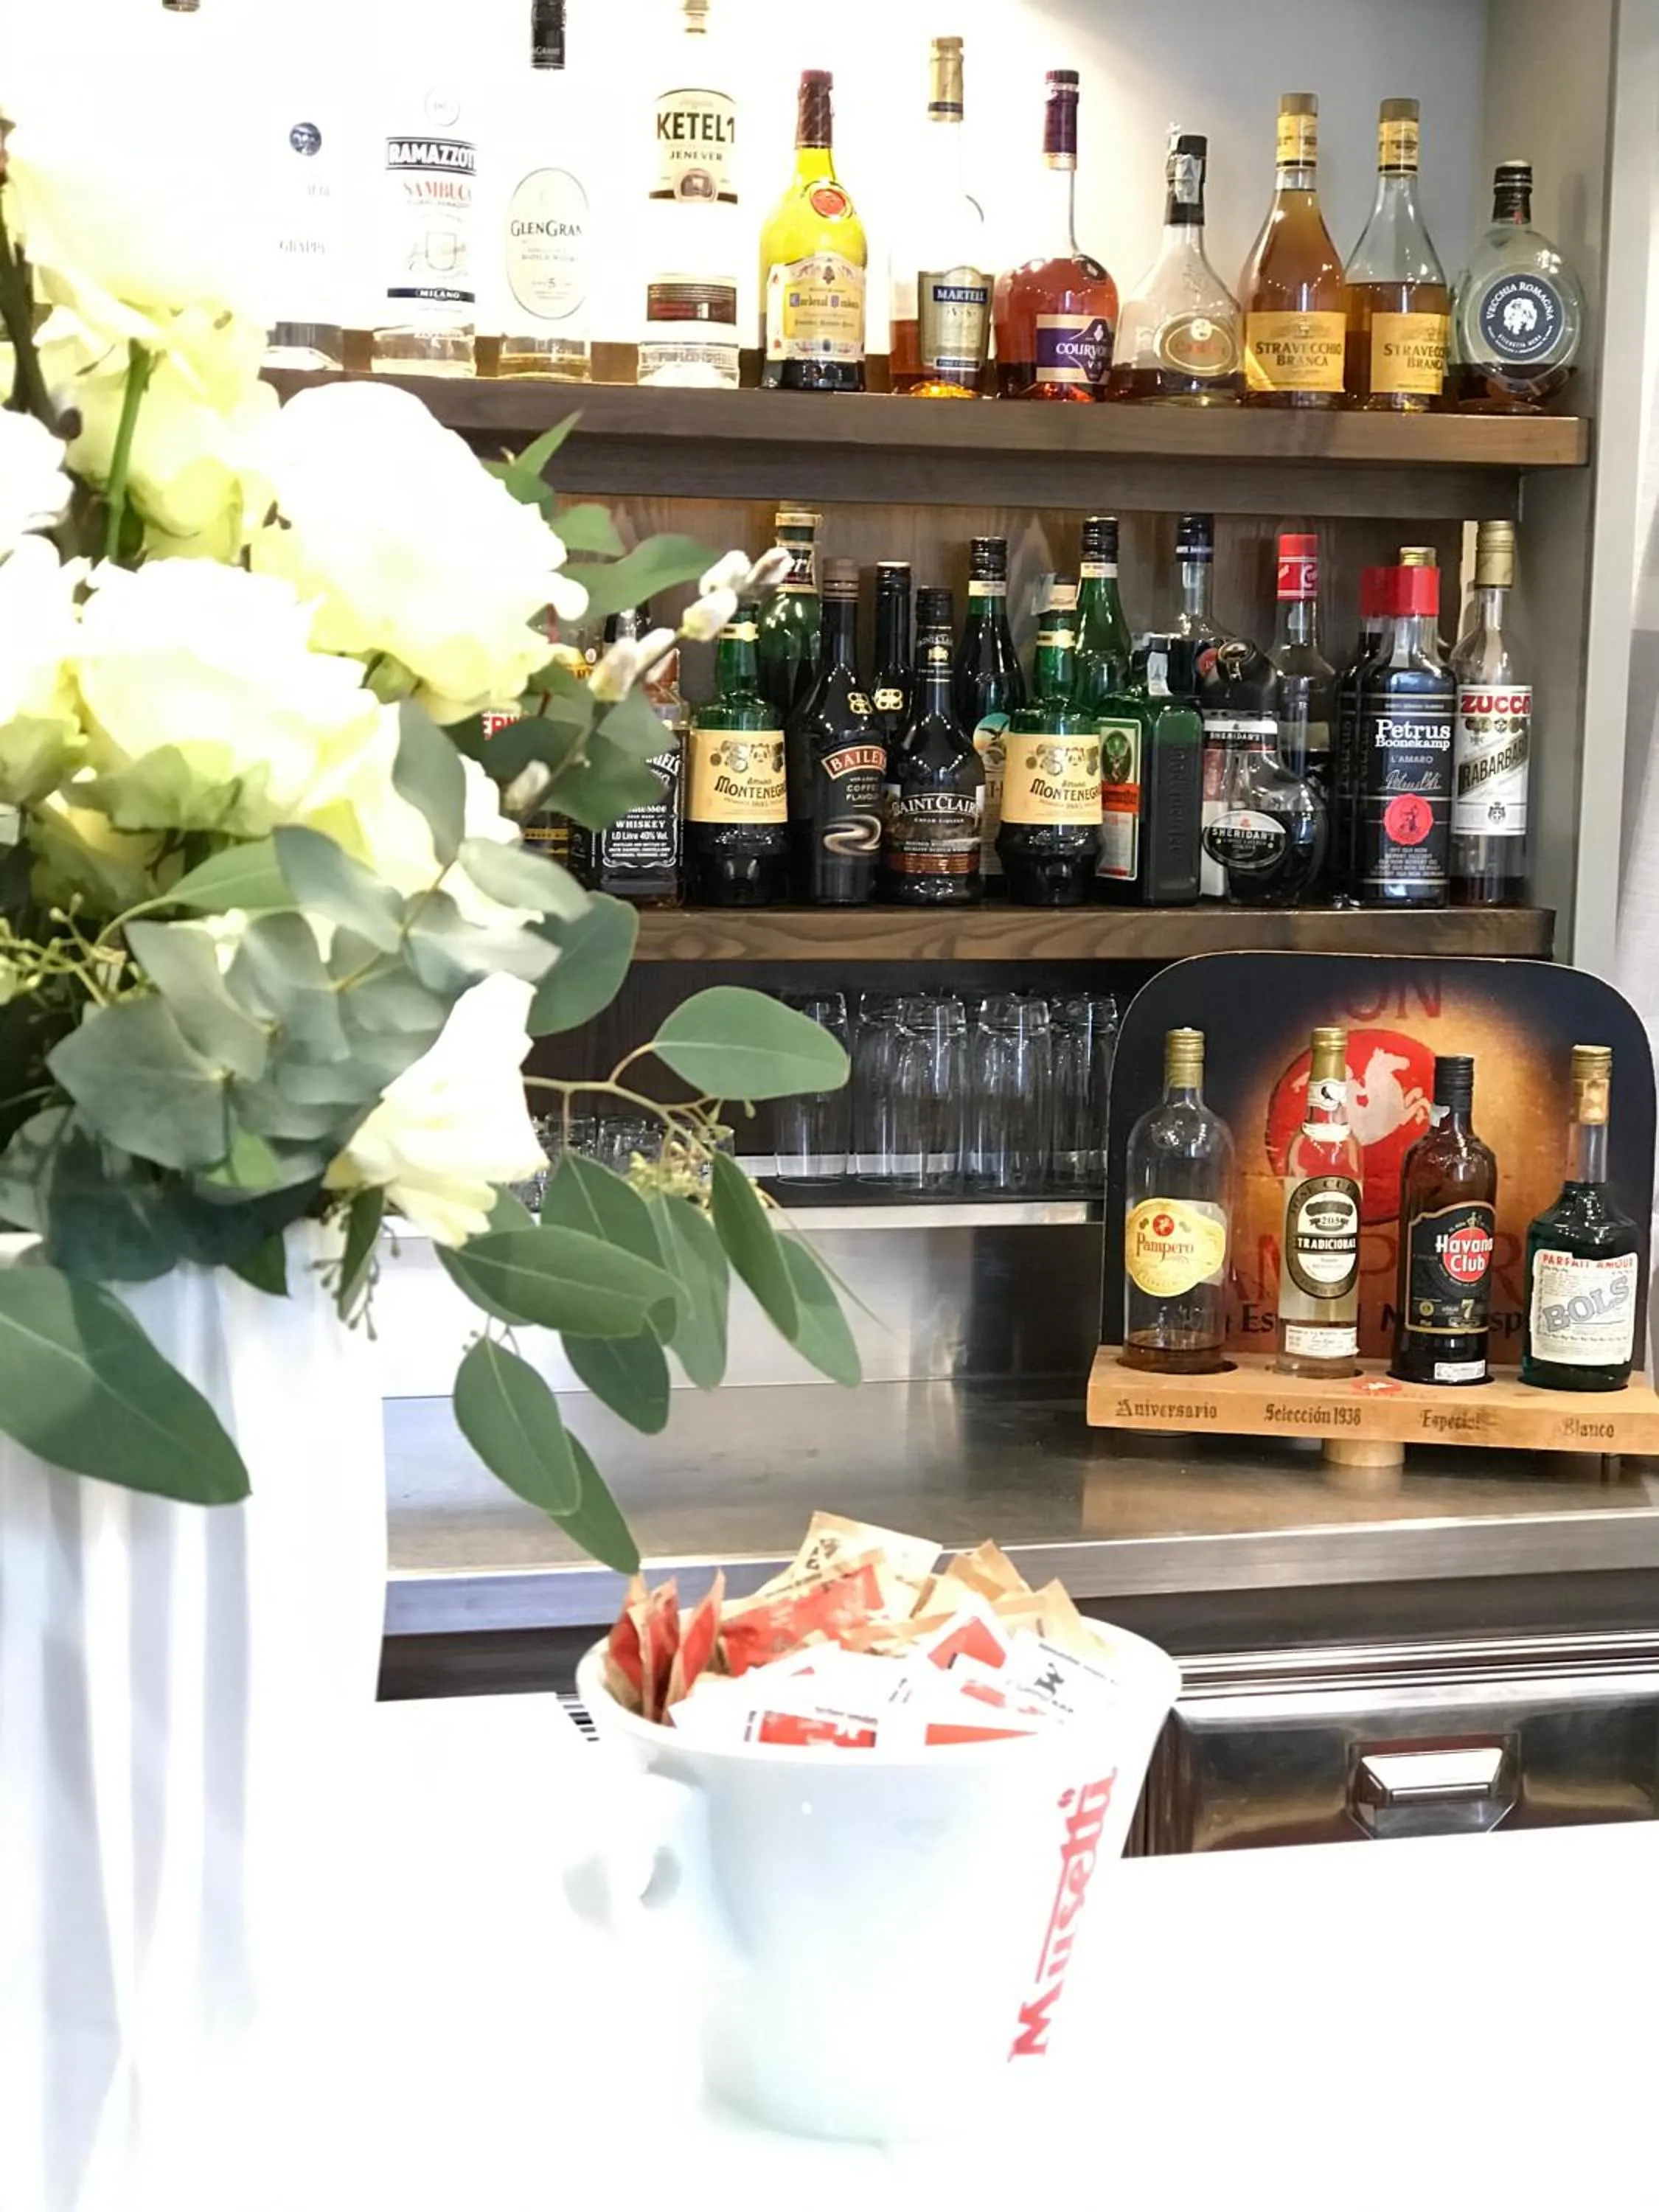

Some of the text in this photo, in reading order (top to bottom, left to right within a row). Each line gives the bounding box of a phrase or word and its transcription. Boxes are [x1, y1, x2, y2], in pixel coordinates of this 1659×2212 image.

[420, 289, 460, 299] MILANO
[937, 288, 984, 302] MARTELL
[1486, 281, 1555, 321] VECCHIA ROMAGNA
[1277, 355, 1329, 366] BRANCA
[1376, 719, 1451, 739] Petrus
[1375, 735, 1450, 751] Boonekamp
[616, 820, 666, 829] WHISKEY
[1136, 1231, 1202, 1262] Pampero
[1435, 1234, 1493, 1253] Havana
[1450, 1255, 1485, 1273] Club
[1461, 1298, 1475, 1319] 7
[1543, 1275, 1630, 1332] BOLS
[1115, 1399, 1218, 1419] Aniversario
[1264, 1403, 1332, 1424] Selección
[1562, 1418, 1615, 1438] Blanco
[1007, 1765, 1119, 2063] Musetti
